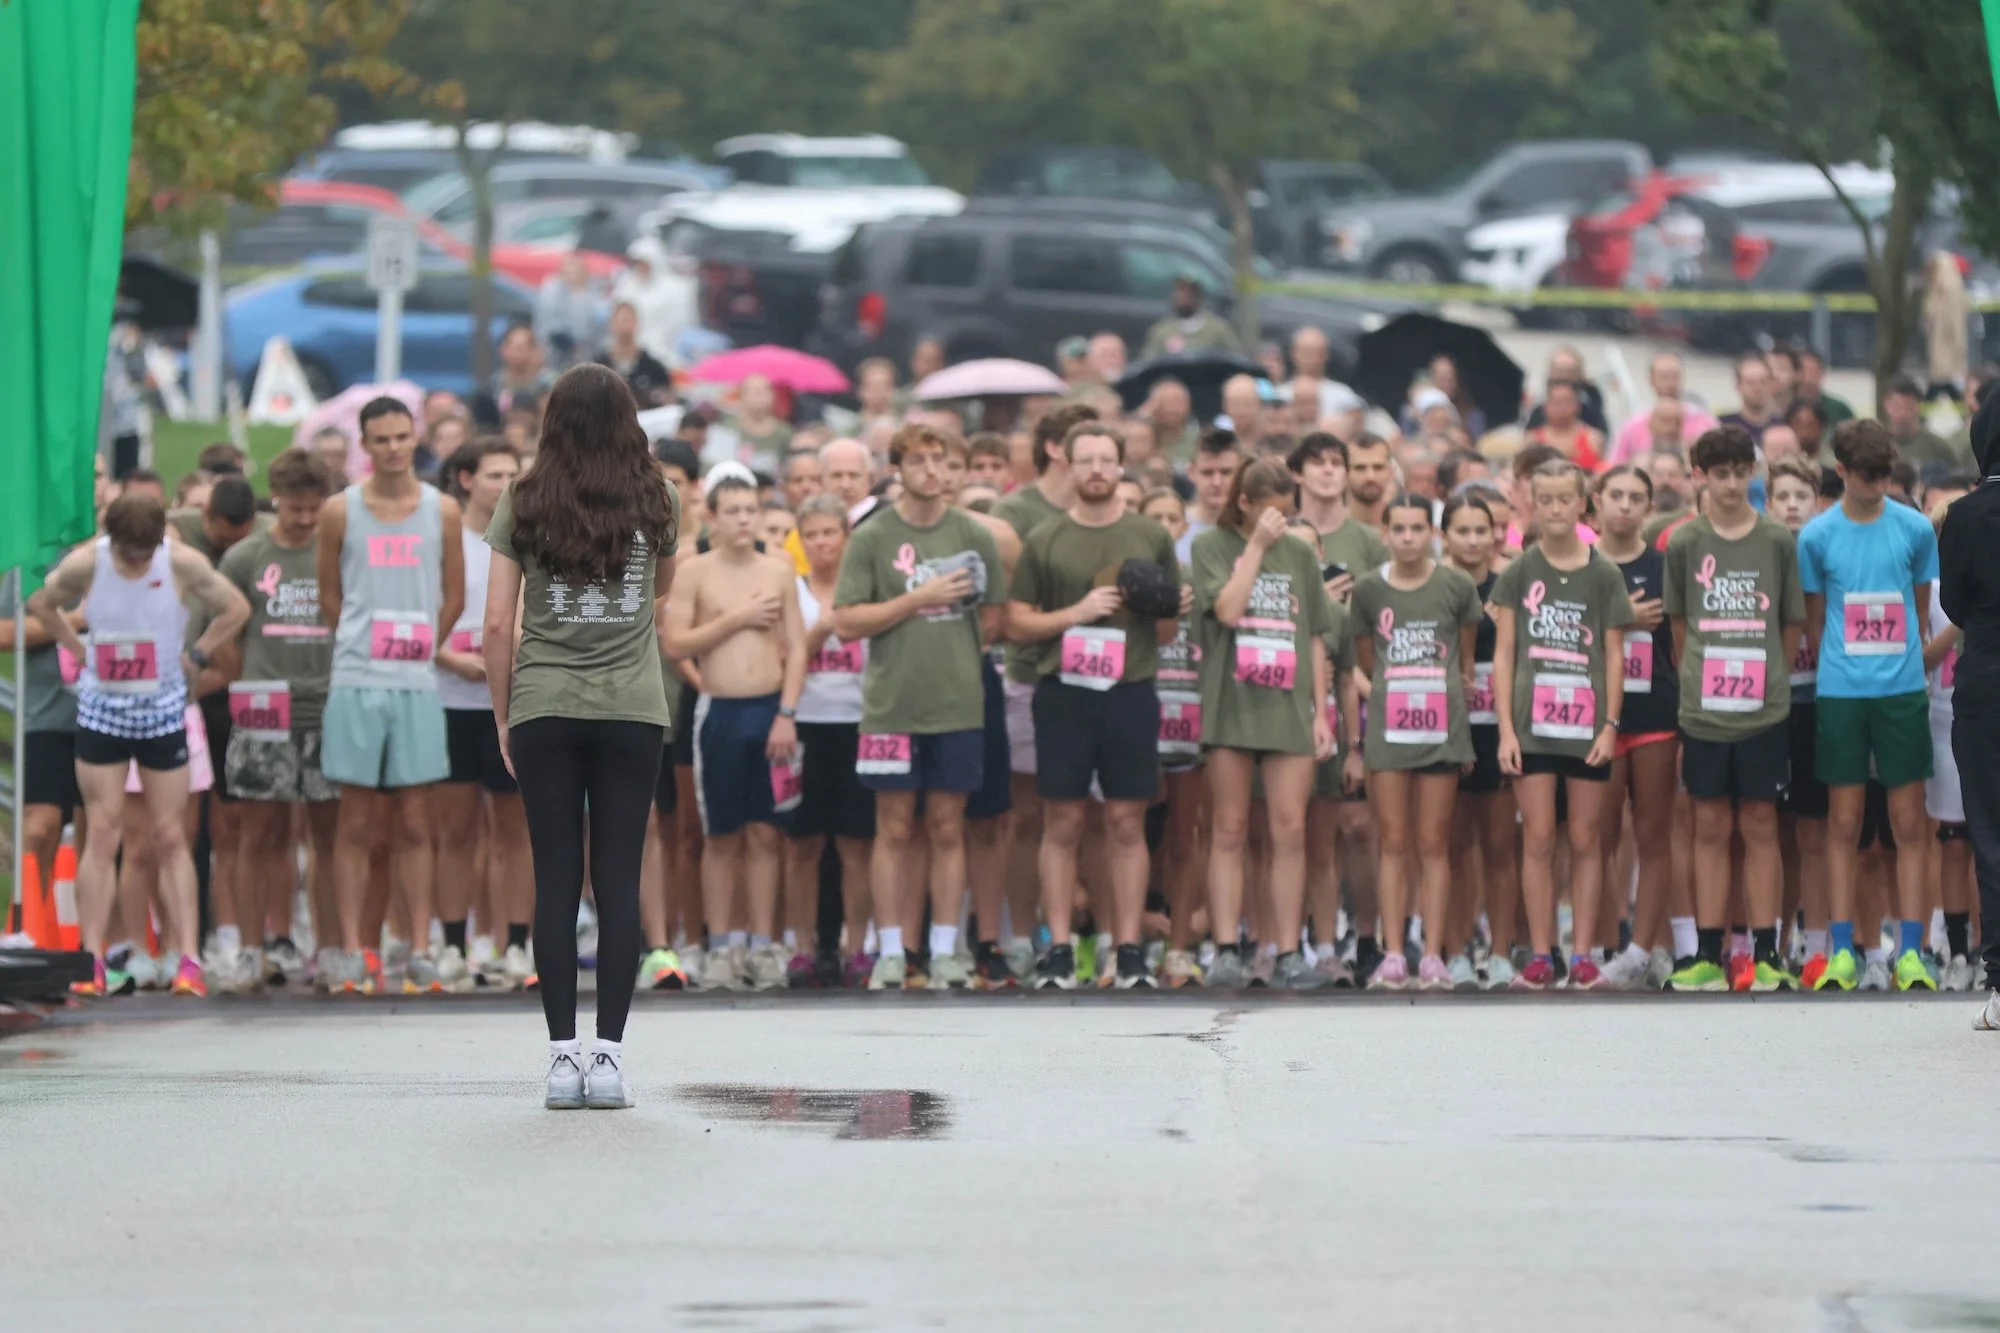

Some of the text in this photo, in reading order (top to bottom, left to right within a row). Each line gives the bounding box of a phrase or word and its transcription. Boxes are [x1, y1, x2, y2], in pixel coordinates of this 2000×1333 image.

[1855, 619, 1896, 641] 237
[381, 638, 424, 660] 739
[107, 659, 147, 681] 727
[1072, 652, 1114, 677] 246
[1713, 676, 1754, 698] 272
[1397, 708, 1438, 731] 280
[1543, 703, 1586, 724] 247
